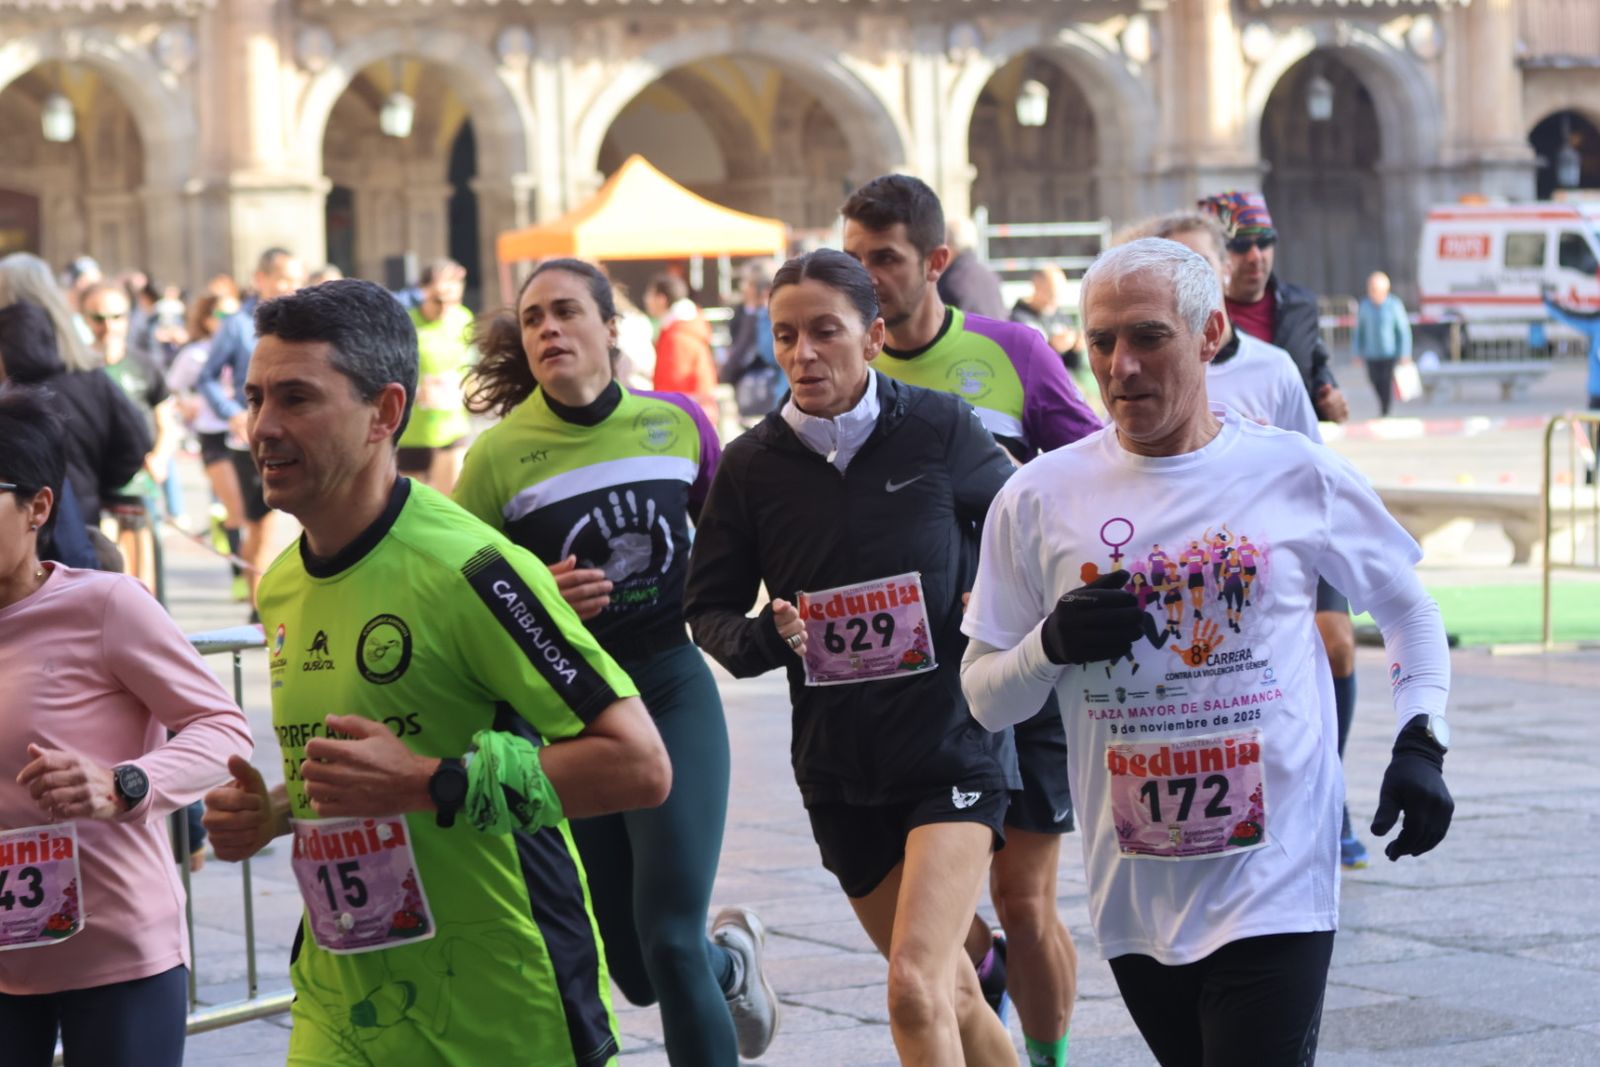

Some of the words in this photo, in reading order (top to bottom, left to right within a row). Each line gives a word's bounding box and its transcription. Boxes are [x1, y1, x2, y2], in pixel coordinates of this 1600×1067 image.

[492, 580, 578, 684] CARBAJOSA
[824, 612, 896, 654] 629
[1165, 670, 1192, 681] CONTRA
[1193, 670, 1201, 678] LA
[1202, 665, 1235, 677] VIOLENCIA
[1235, 664, 1245, 672] DE
[1206, 648, 1253, 667] CARRERA
[1088, 709, 1124, 720] PLAZA
[1128, 704, 1176, 719] MAYOR
[1181, 703, 1198, 714] DE
[1203, 689, 1283, 711] SALAMANCA
[1111, 724, 1118, 734] 9
[1122, 723, 1136, 735] de
[1140, 716, 1208, 732] noviembre
[1213, 714, 1229, 726] de
[1234, 709, 1261, 723] 2025
[1107, 739, 1261, 777] bedunia
[1139, 774, 1232, 822] 172
[0, 866, 44, 911] 43
[317, 859, 368, 912] 15
